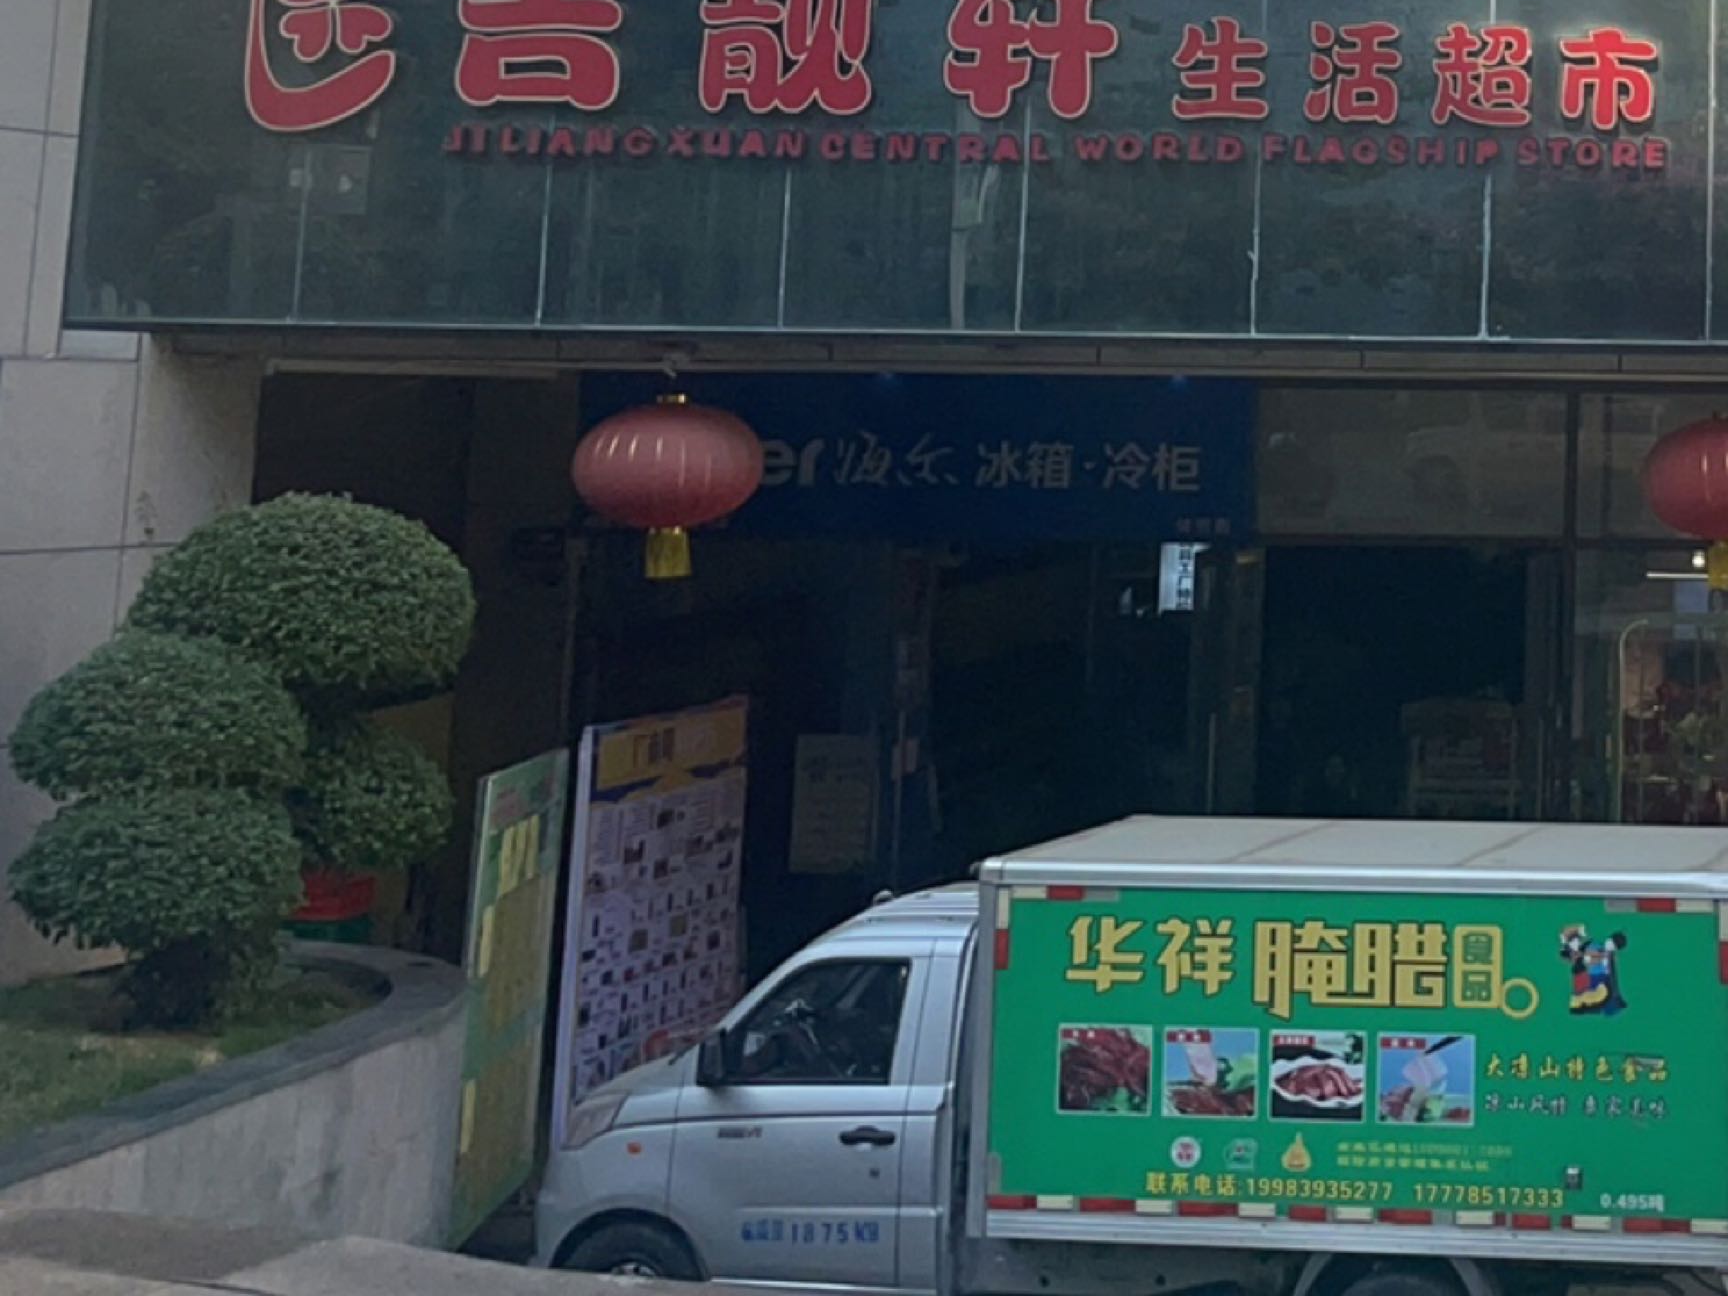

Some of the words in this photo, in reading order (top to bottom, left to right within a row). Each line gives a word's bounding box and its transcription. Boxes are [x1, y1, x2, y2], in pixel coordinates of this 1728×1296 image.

[1075, 134, 1246, 164] WORLD
[1516, 137, 1668, 170] STORE
[1414, 1184, 1565, 1209] 17778517333
